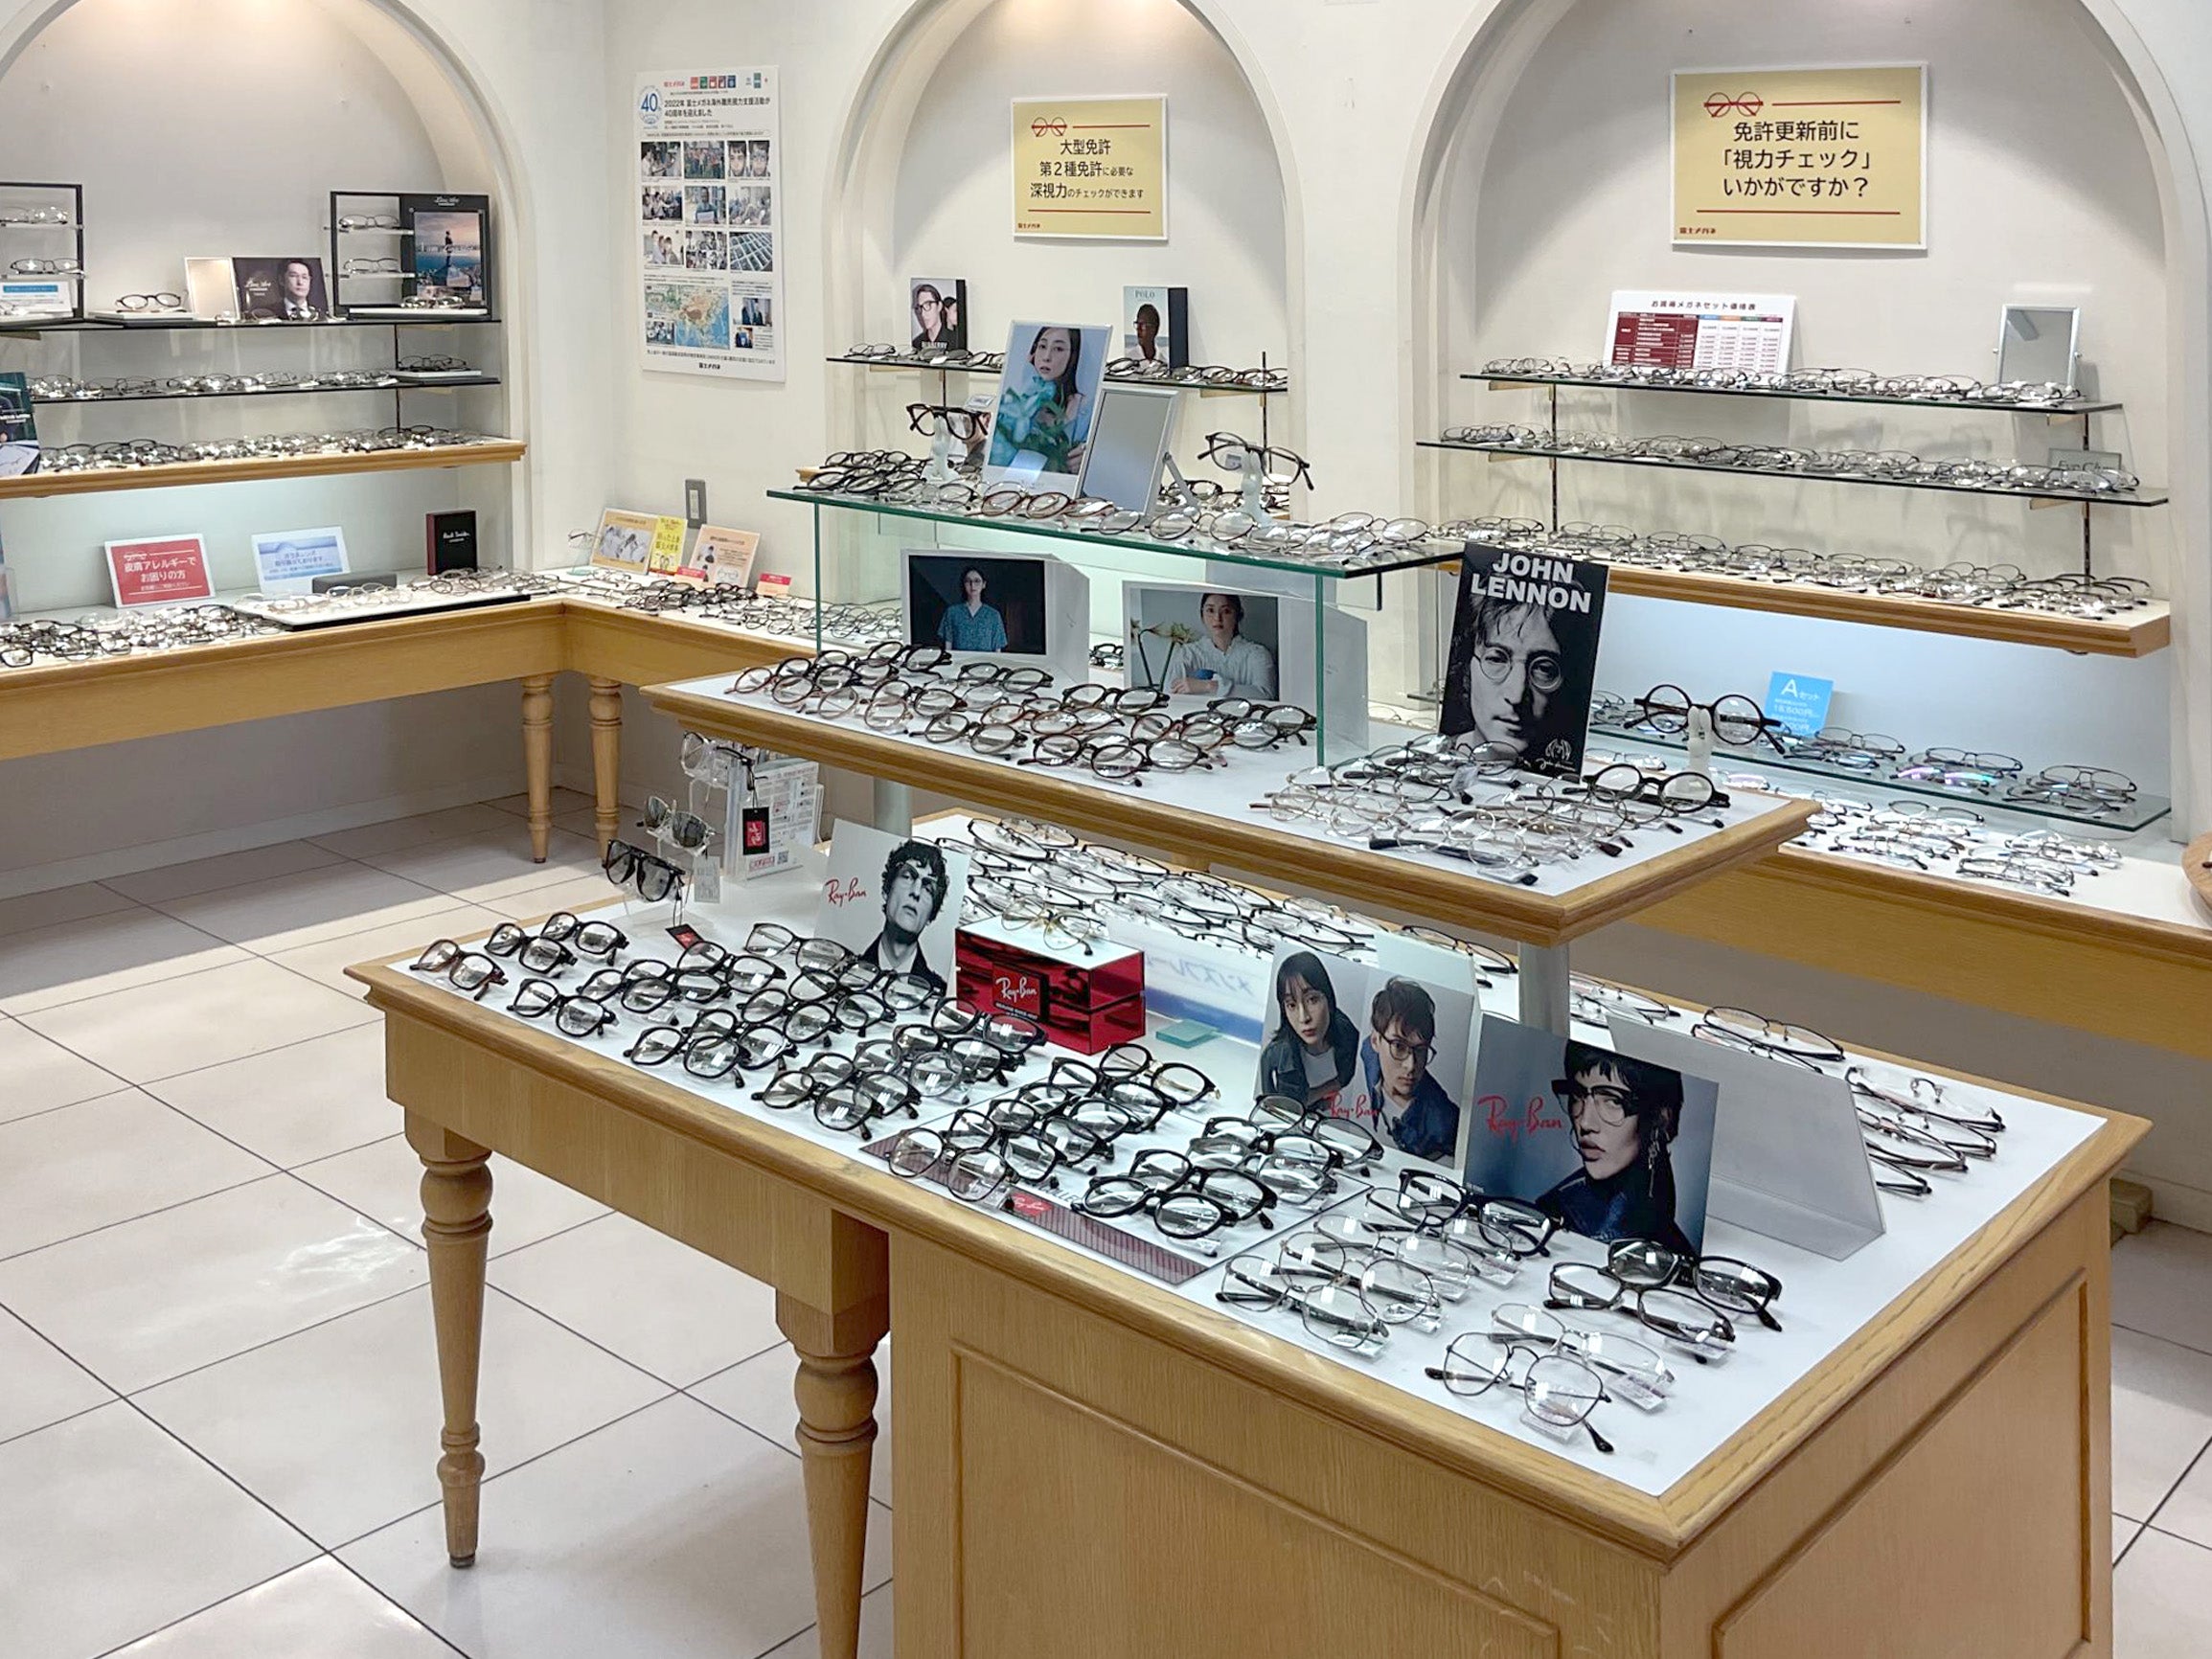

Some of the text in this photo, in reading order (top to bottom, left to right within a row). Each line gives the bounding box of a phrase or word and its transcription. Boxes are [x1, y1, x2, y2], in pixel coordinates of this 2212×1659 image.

[641, 93, 658, 112] 40
[1733, 121, 1859, 142] 免許更新前に
[1060, 139, 1111, 156] 大型免許
[1724, 148, 1870, 170] 「視力チェック」
[1039, 161, 1134, 177] 第2種免許に必要な
[1030, 182, 1144, 199] 深視力のチェックができます
[1723, 177, 1869, 197] いかがですか?
[1134, 289, 1155, 299] POLO
[1492, 553, 1574, 583] JOHN
[1471, 573, 1591, 614] LENNON
